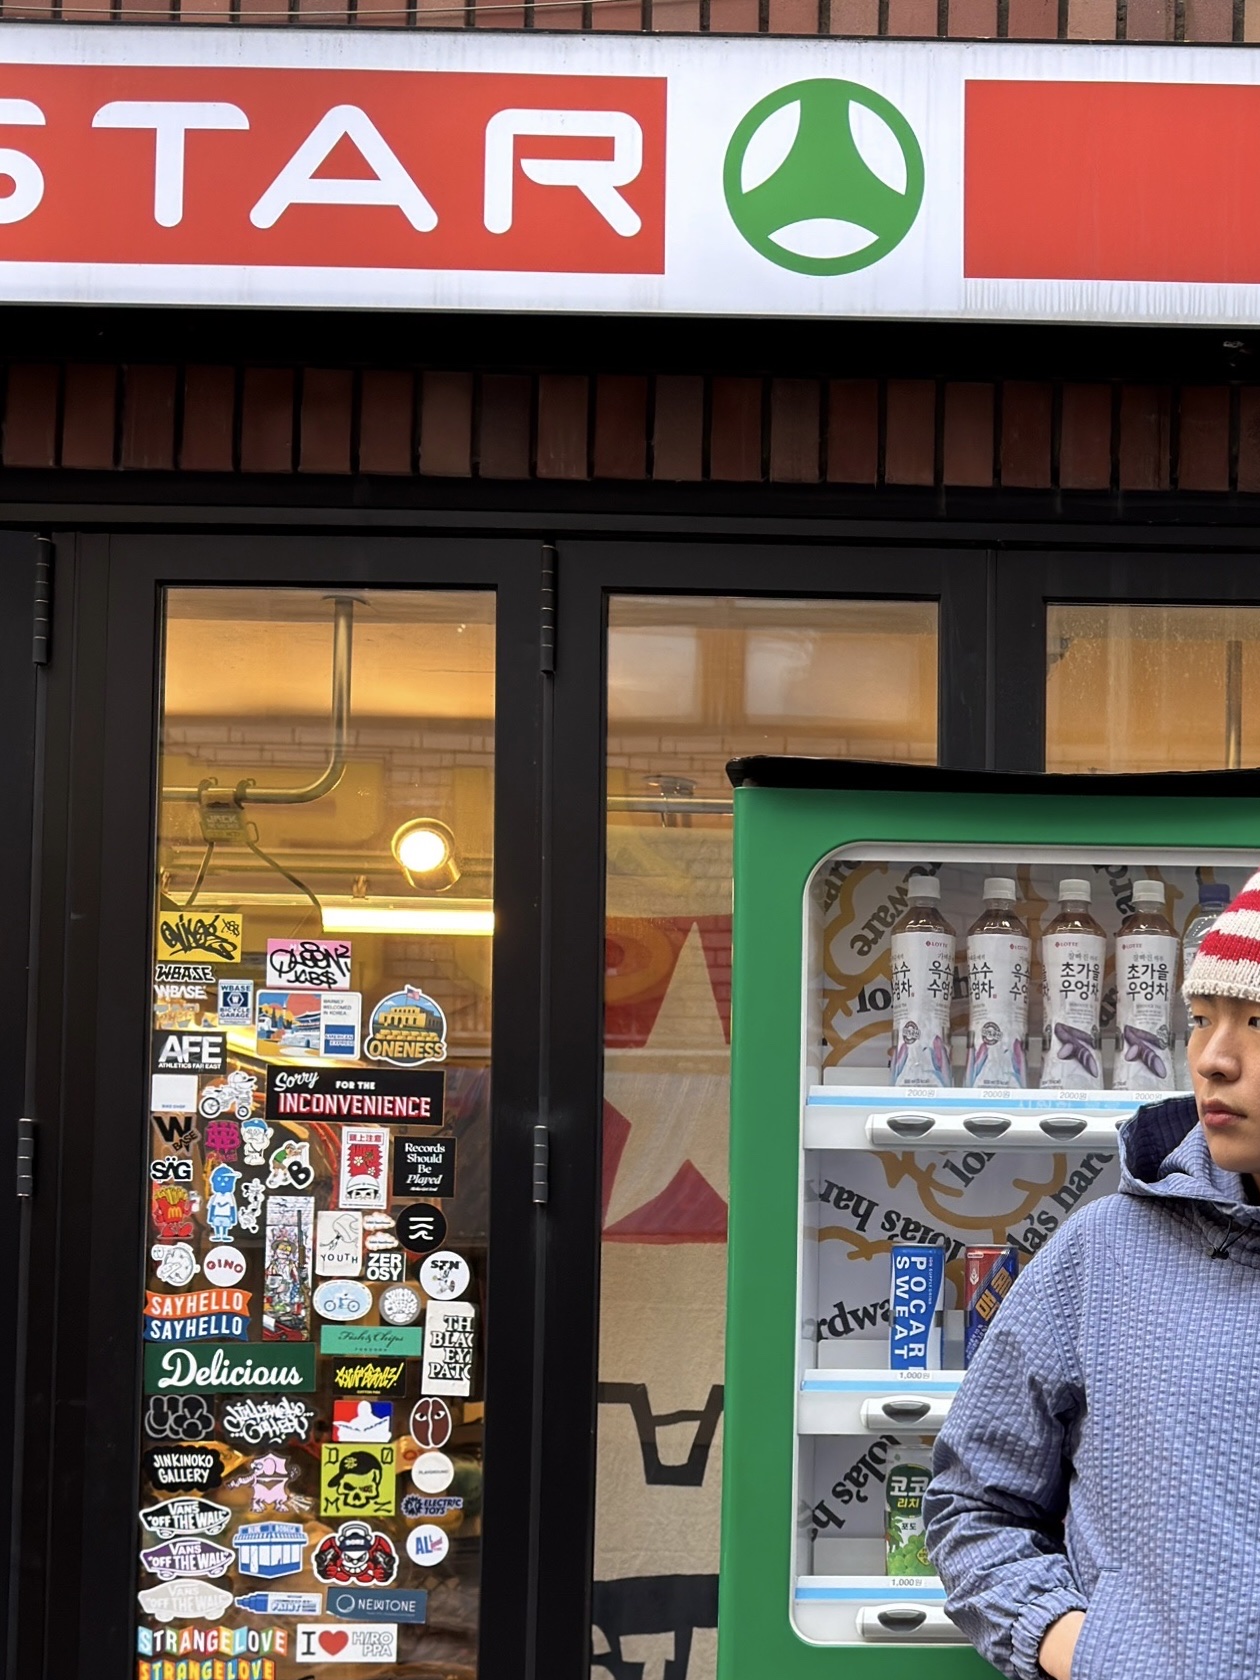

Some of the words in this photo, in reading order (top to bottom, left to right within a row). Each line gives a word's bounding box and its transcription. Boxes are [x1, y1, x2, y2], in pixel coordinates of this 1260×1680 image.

[156, 965, 214, 981] WBASE
[1060, 961, 1101, 981] 초가을
[1127, 963, 1170, 981] 초가을
[154, 984, 208, 999] WBASE
[1059, 979, 1100, 1001] 우엉차
[1126, 980, 1169, 1002] 우엉차
[158, 1035, 223, 1064] AFE
[368, 1040, 444, 1059] ONENESS
[158, 1062, 192, 1070] ATHLETICS
[273, 1071, 320, 1093] Sorry
[335, 1080, 356, 1090] FOR
[356, 1081, 376, 1090] THE
[277, 1092, 431, 1118] INCONVENIENCE
[404, 1142, 446, 1153] Records
[406, 1153, 443, 1164] Should
[417, 1164, 432, 1174] Be
[405, 1174, 443, 1186] Played
[206, 1258, 244, 1274] GINO
[320, 1253, 359, 1264] YOUTH
[368, 1253, 403, 1268] ZER
[366, 1267, 402, 1281] OSY
[151, 1292, 243, 1316] SAYHELLO
[894, 1255, 910, 1359] SWEAT
[150, 1316, 243, 1340] SAYHELLO
[157, 1348, 304, 1389] Delicious
[153, 1453, 214, 1468] JINKINOKO
[158, 1468, 210, 1484] GALLERY
[168, 1501, 200, 1516] VANS
[423, 1498, 463, 1508] ELECTRIC
[423, 1506, 446, 1515] TOYS
[897, 1497, 919, 1509] 리치
[172, 1513, 195, 1530] THE
[901, 1521, 917, 1532] 포도
[169, 1542, 201, 1556] VANS
[173, 1556, 197, 1571] THE
[358, 1599, 416, 1612] NEWTONE
[138, 1629, 286, 1653] STRANGELOVE
[301, 1630, 317, 1656] I
